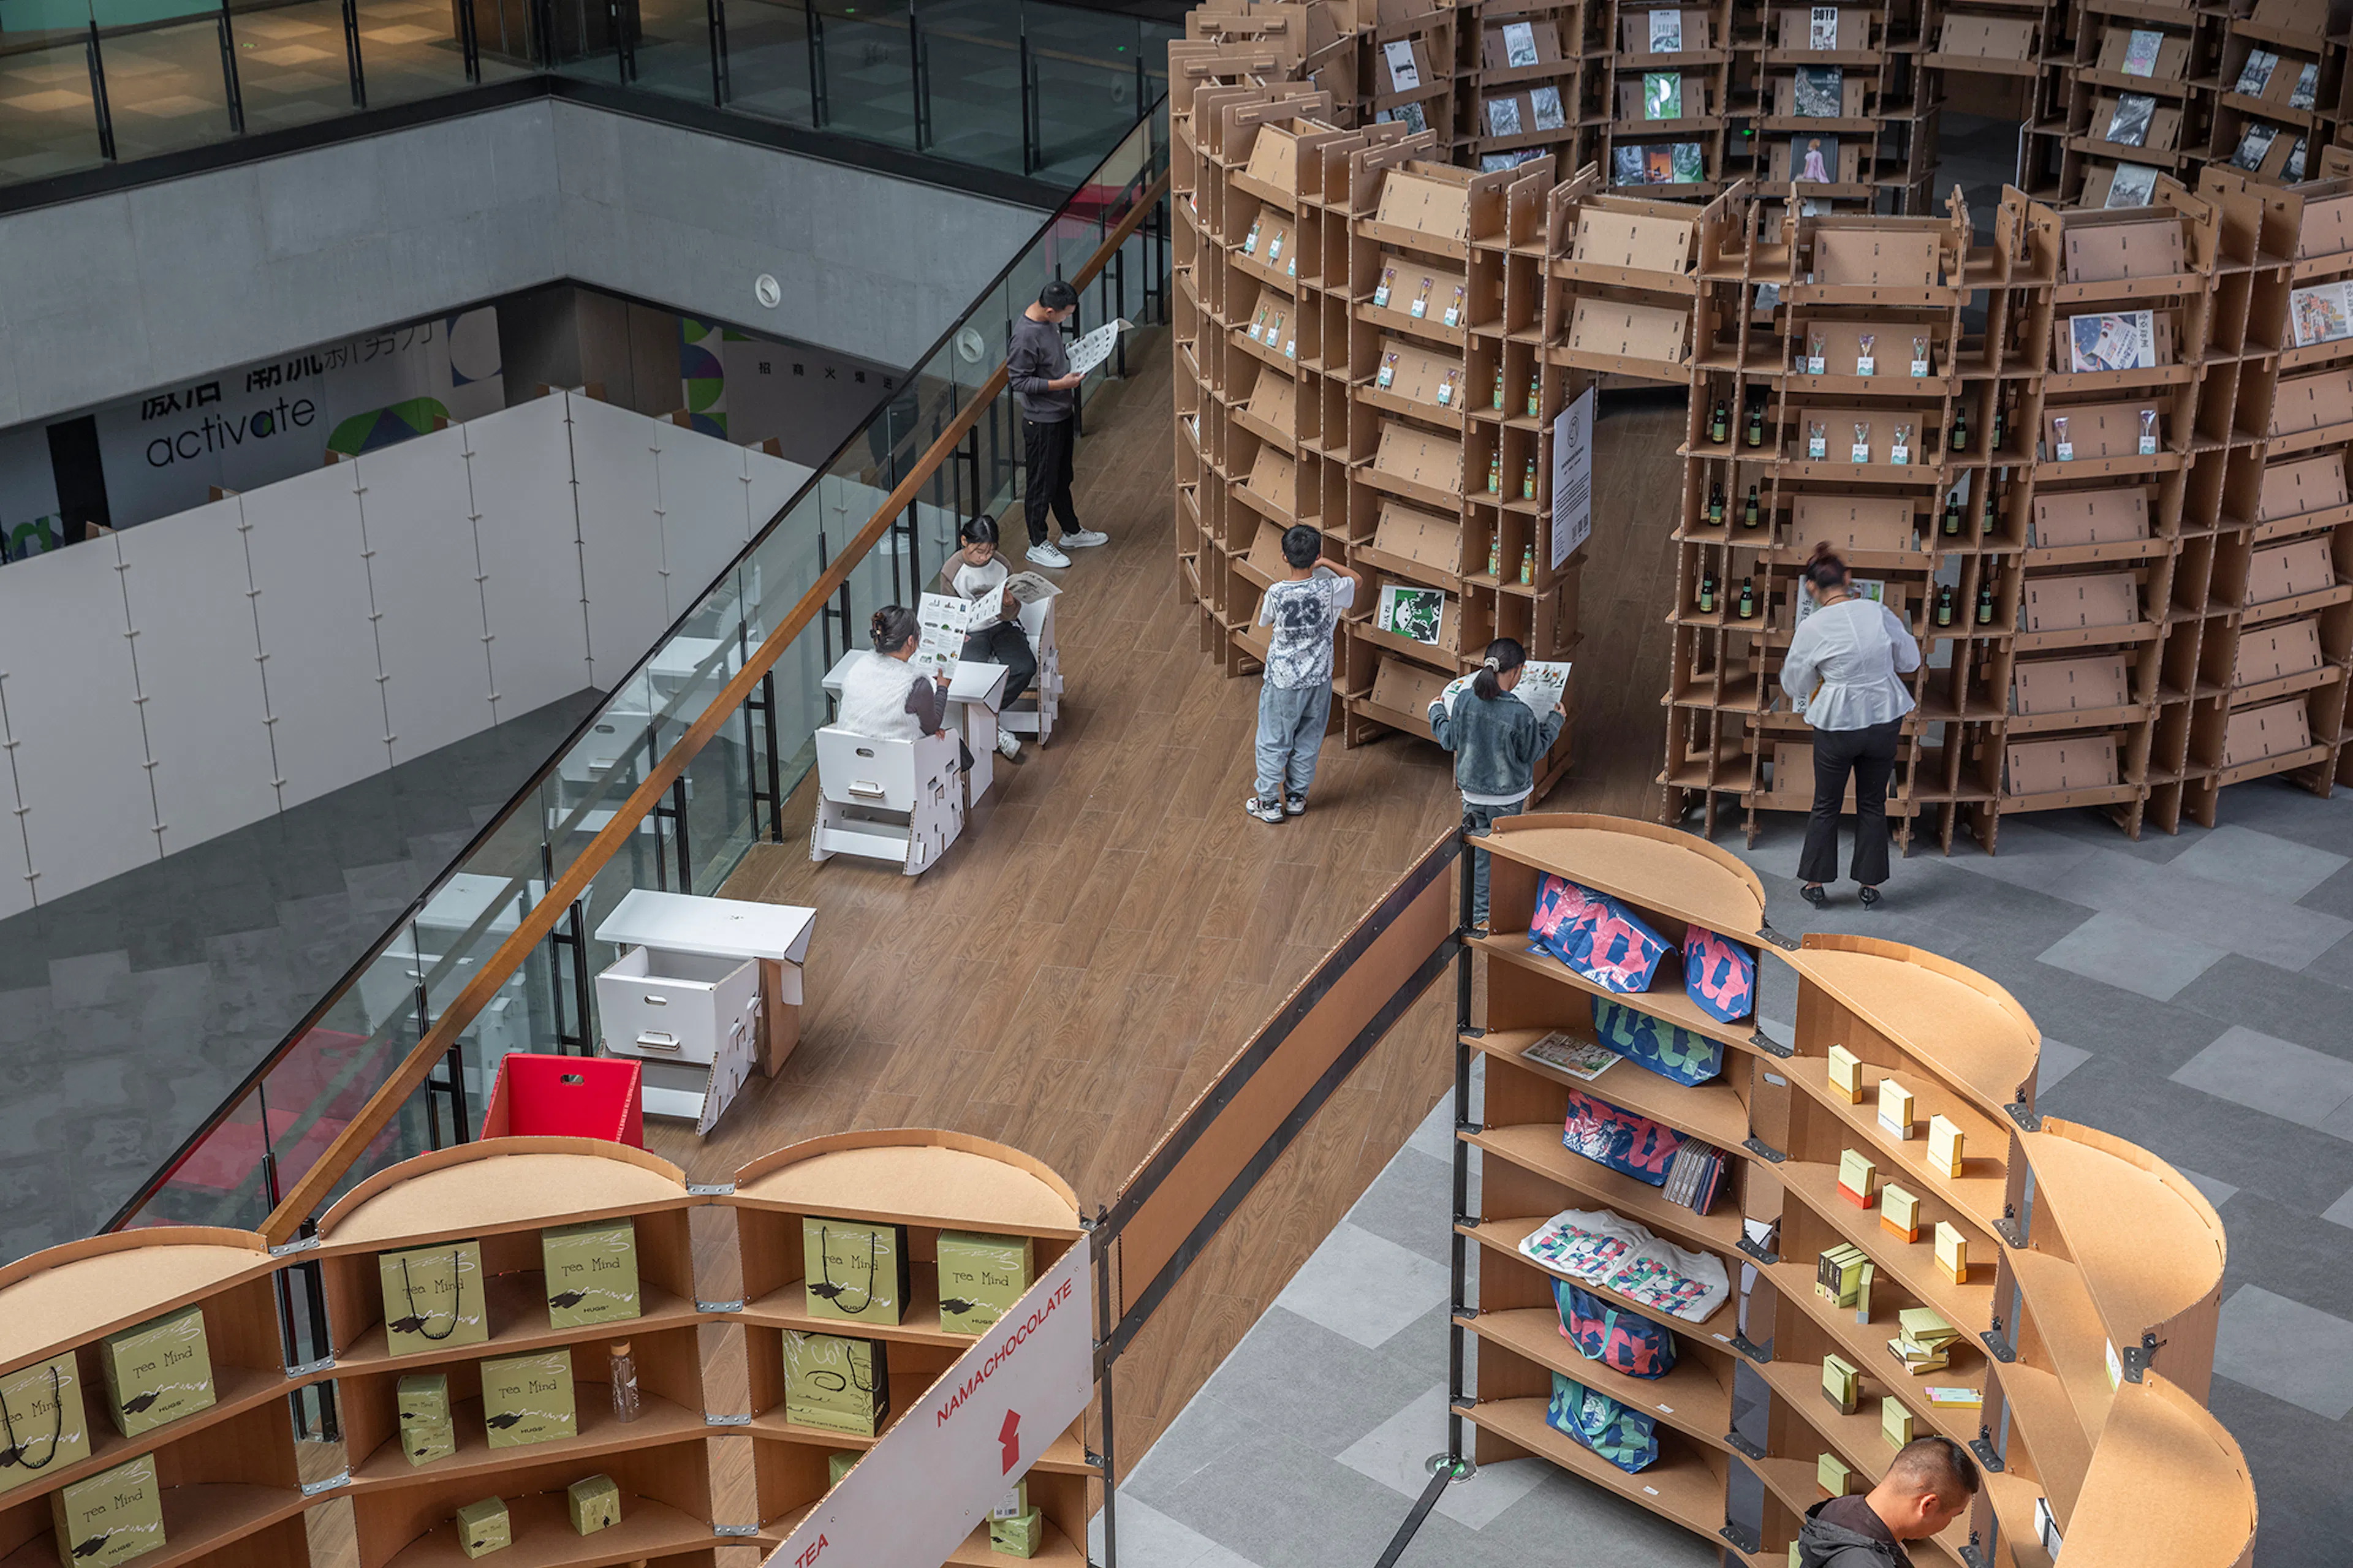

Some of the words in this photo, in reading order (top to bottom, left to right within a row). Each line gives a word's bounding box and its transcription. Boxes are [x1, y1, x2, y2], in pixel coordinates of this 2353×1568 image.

[146, 396, 315, 468] activate
[1283, 597, 1322, 627] 23
[561, 1264, 583, 1276] Tea
[592, 1257, 620, 1271] Mind
[952, 1271, 974, 1284] Tea
[982, 1271, 1009, 1286] Mind
[434, 1278, 464, 1294] Mind
[133, 1362, 156, 1379] Tea
[164, 1346, 193, 1367] Mind
[936, 1278, 1072, 1428] NAMACHOCOLATE
[499, 1386, 521, 1399] Tea
[529, 1379, 557, 1394] Mind
[83, 1506, 106, 1523] Tea
[114, 1488, 143, 1510] Mind
[795, 1533, 829, 1568] TEA
